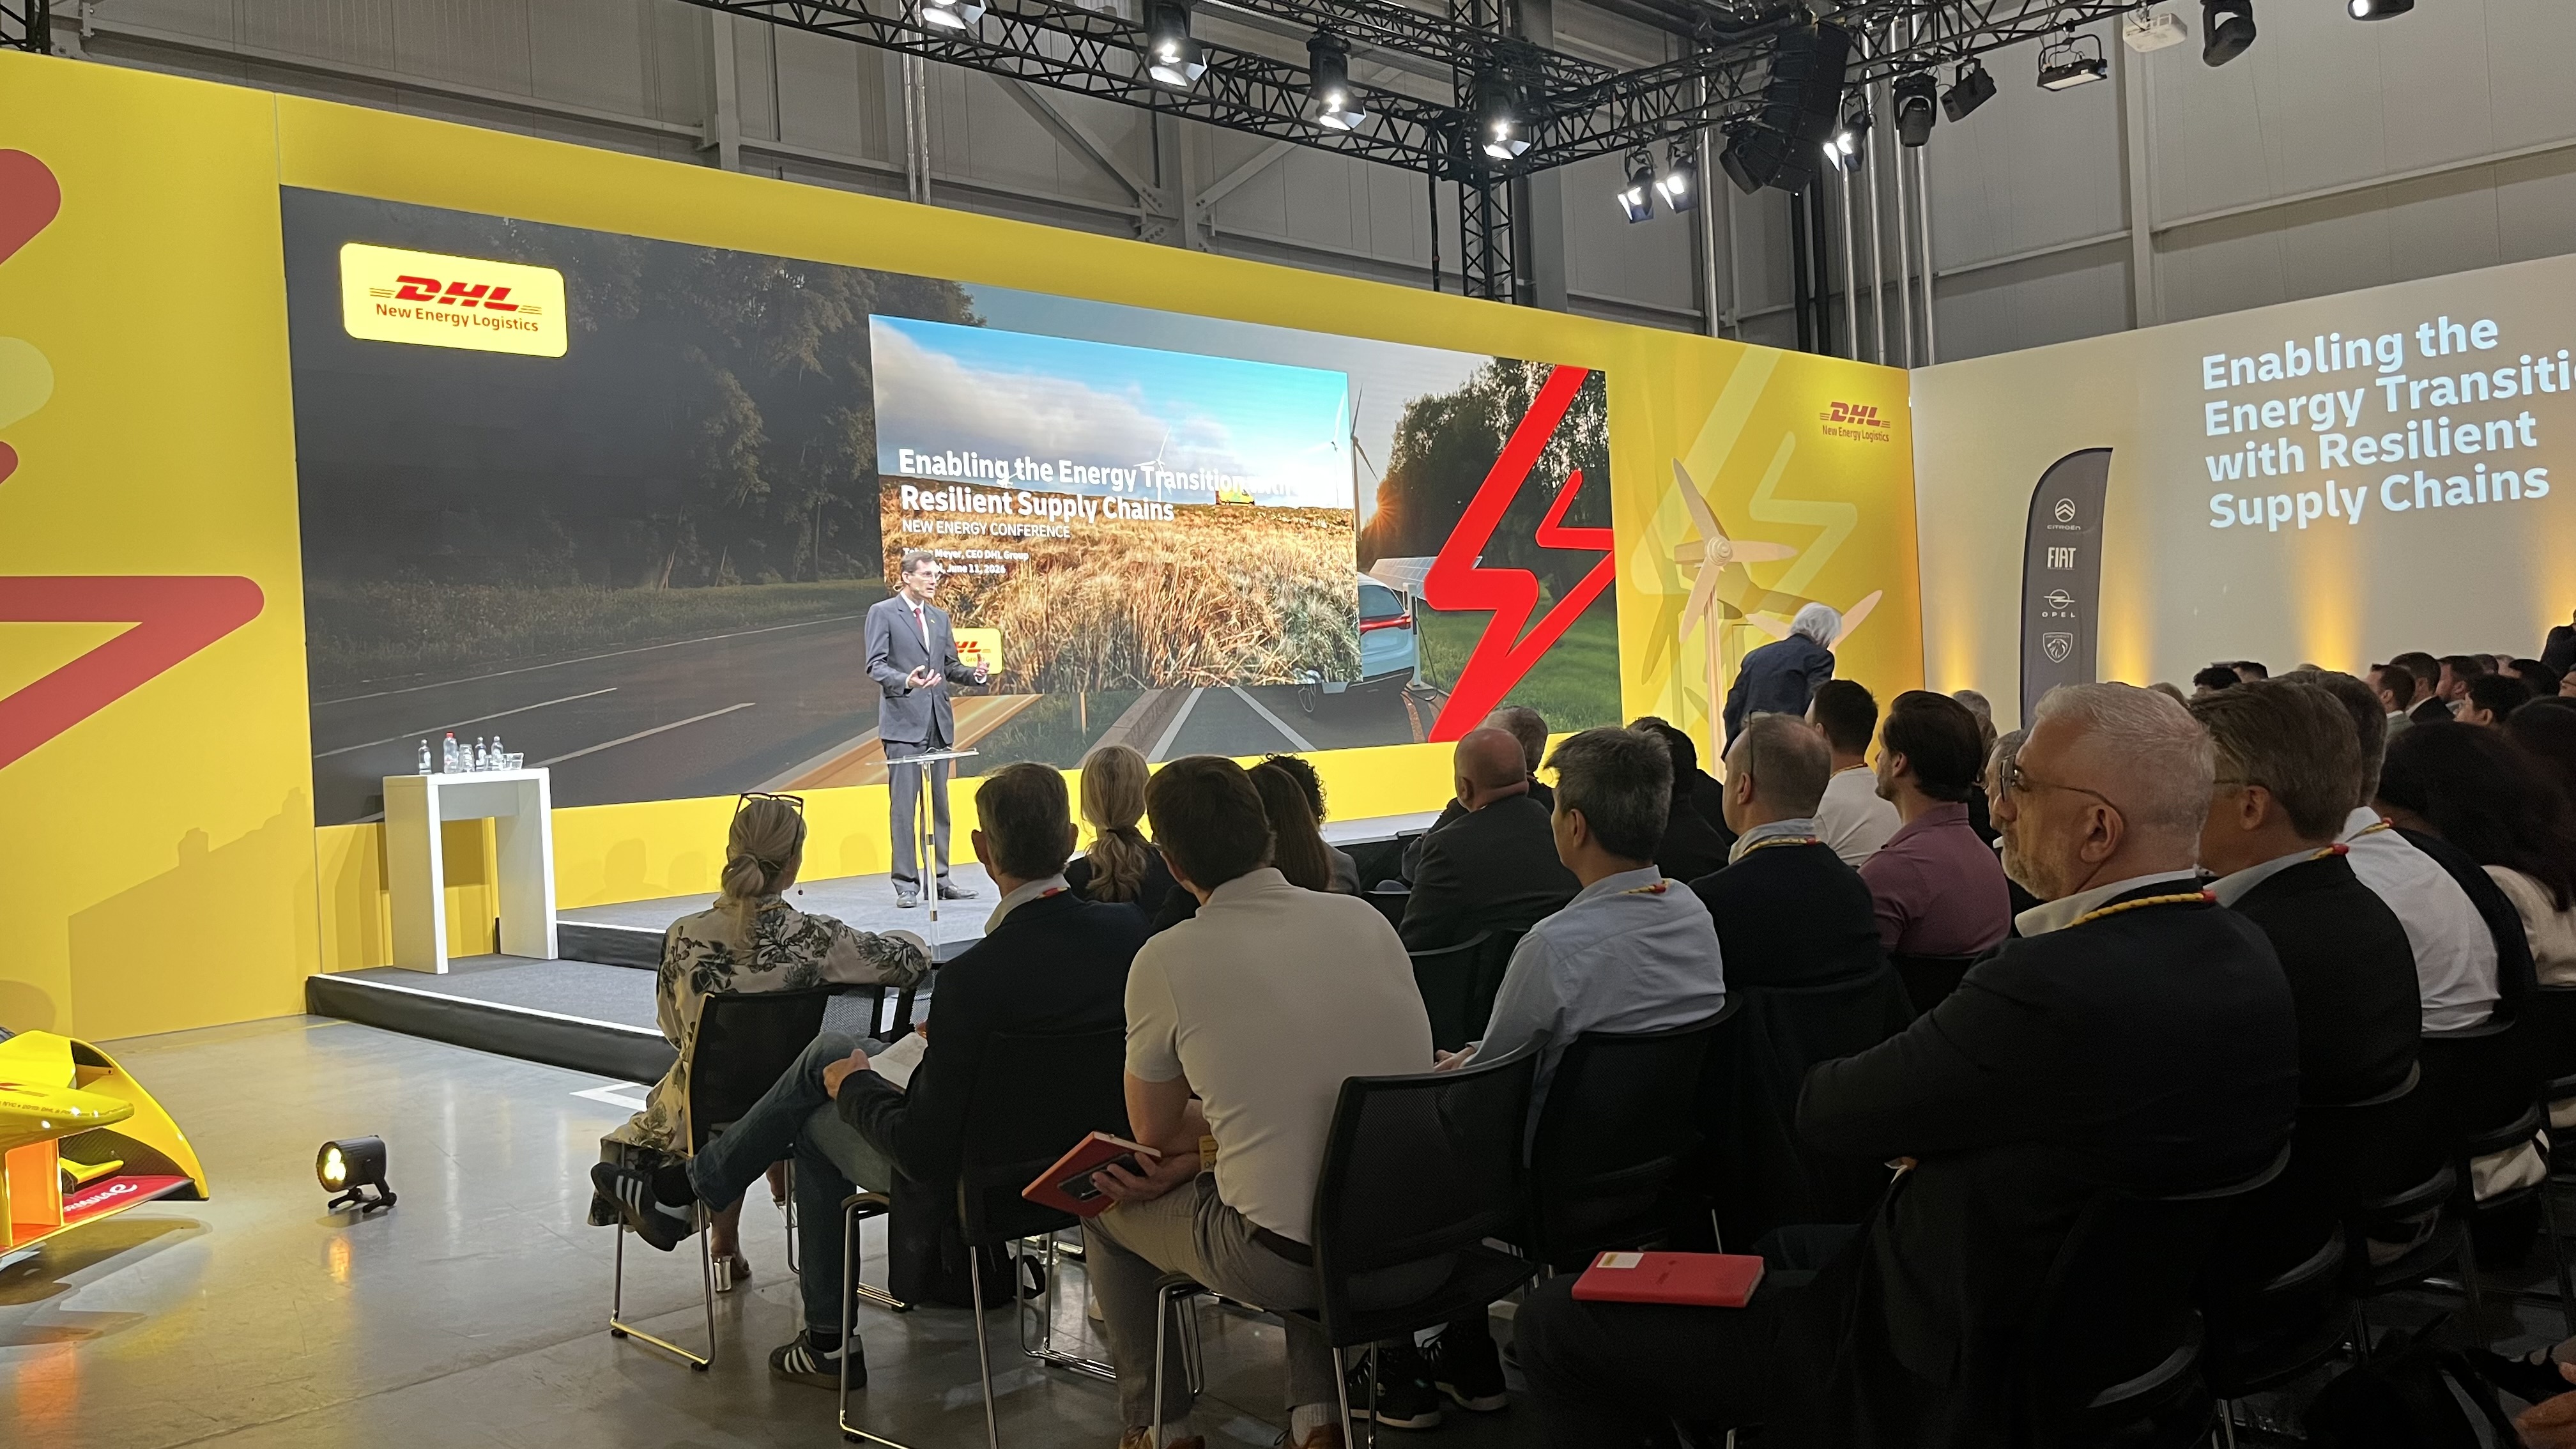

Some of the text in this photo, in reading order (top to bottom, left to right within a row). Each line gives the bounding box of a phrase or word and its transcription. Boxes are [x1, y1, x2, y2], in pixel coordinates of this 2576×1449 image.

[394, 275, 519, 312] DHL
[376, 303, 539, 332] New Energy Logistics
[2202, 316, 2499, 390] Enabling the
[2205, 349, 2576, 436] Energy Transiti
[1830, 401, 1882, 427] DHL
[1822, 425, 1889, 443] New Energy Logistics
[2205, 411, 2538, 482] with Resilient
[899, 448, 1010, 485] Enabling
[1015, 456, 1054, 482] the
[1059, 459, 1137, 493] Energy
[1140, 465, 1246, 493] Transition
[900, 484, 1175, 523] Resilient Supply Chains
[2209, 463, 2550, 532] Supply Chains
[902, 519, 1071, 539] NEW ENERGY CONFERENCE
[935, 549, 965, 560] Meyer,
[965, 549, 984, 559] CEO
[985, 550, 1003, 560] DHL
[1004, 551, 1029, 562] Group
[947, 564, 968, 574] June
[969, 564, 983, 574] 11,
[984, 564, 1007, 574] 2026
[2047, 547, 2076, 568] FIAT
